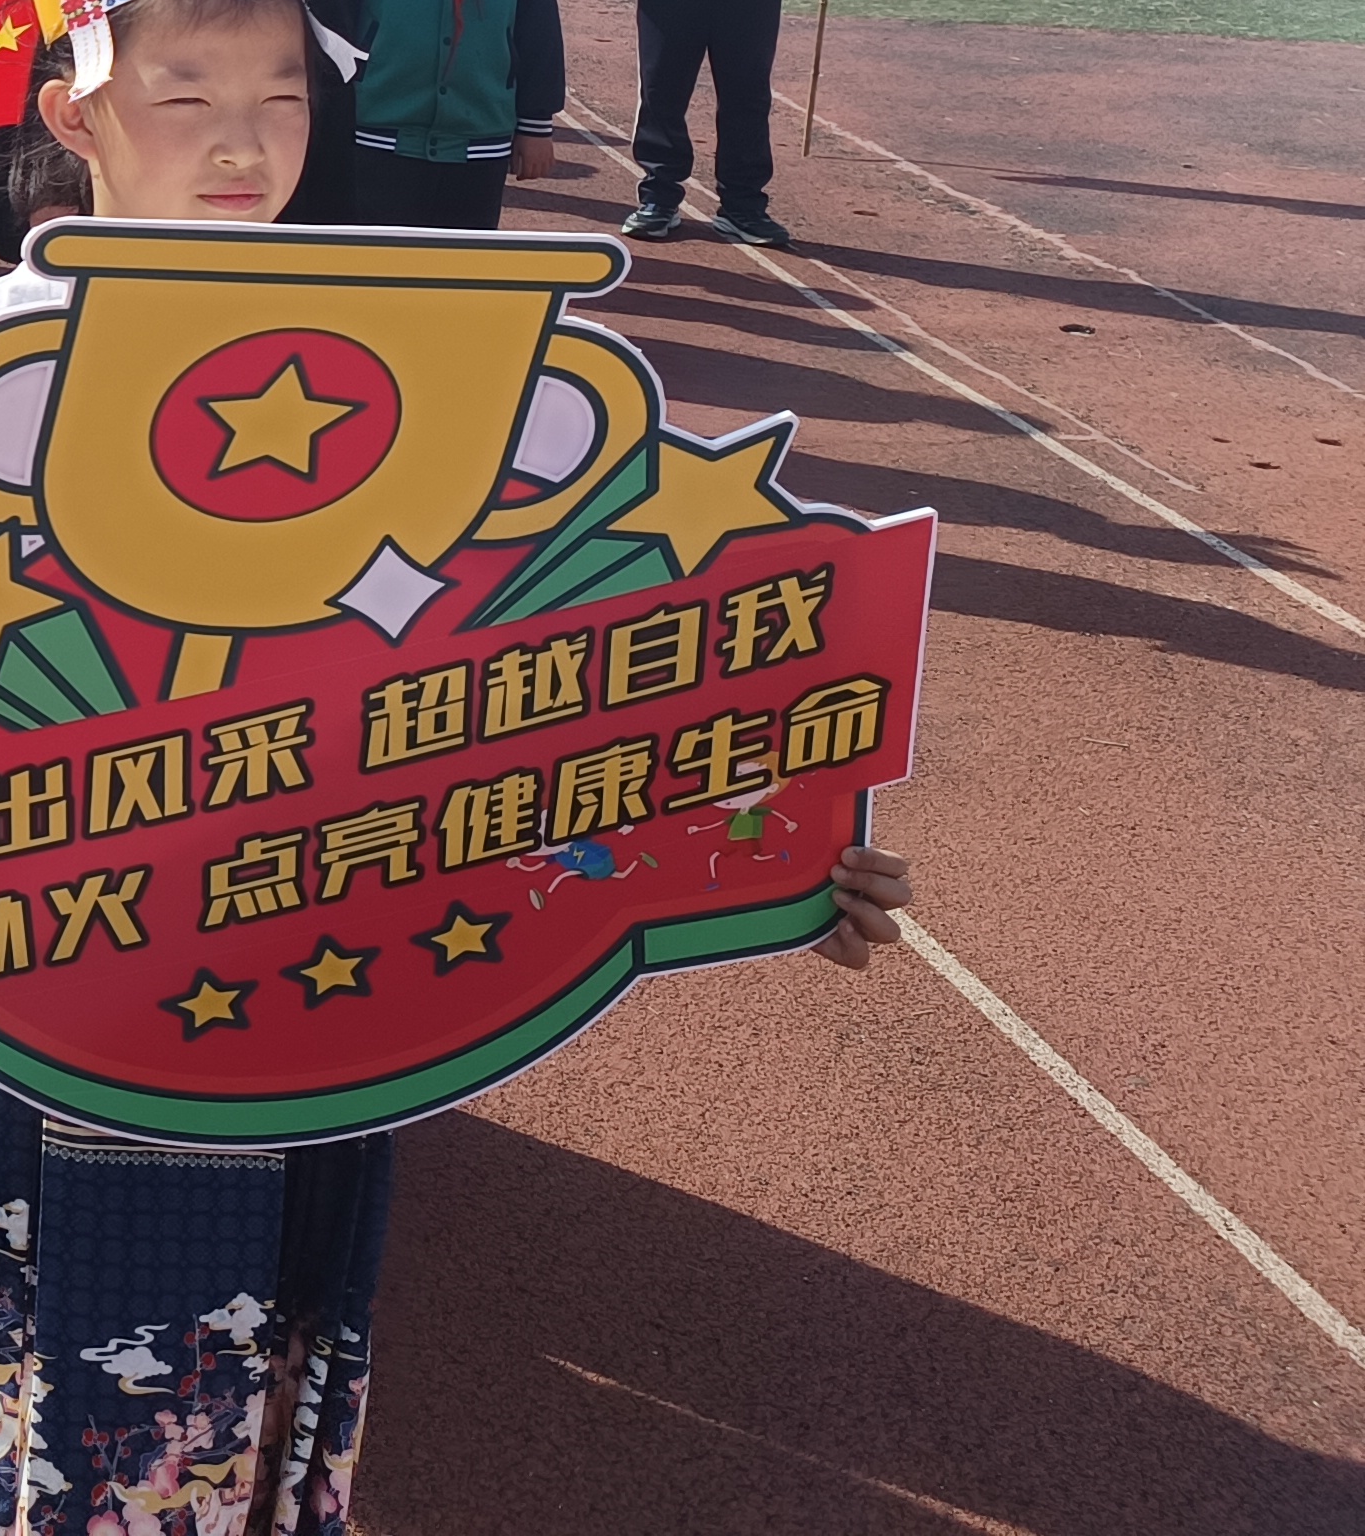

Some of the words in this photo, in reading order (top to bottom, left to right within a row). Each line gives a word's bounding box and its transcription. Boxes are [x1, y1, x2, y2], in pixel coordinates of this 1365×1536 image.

[361, 564, 832, 773] 超越自我
[200, 674, 888, 931] 点亮健康生命
